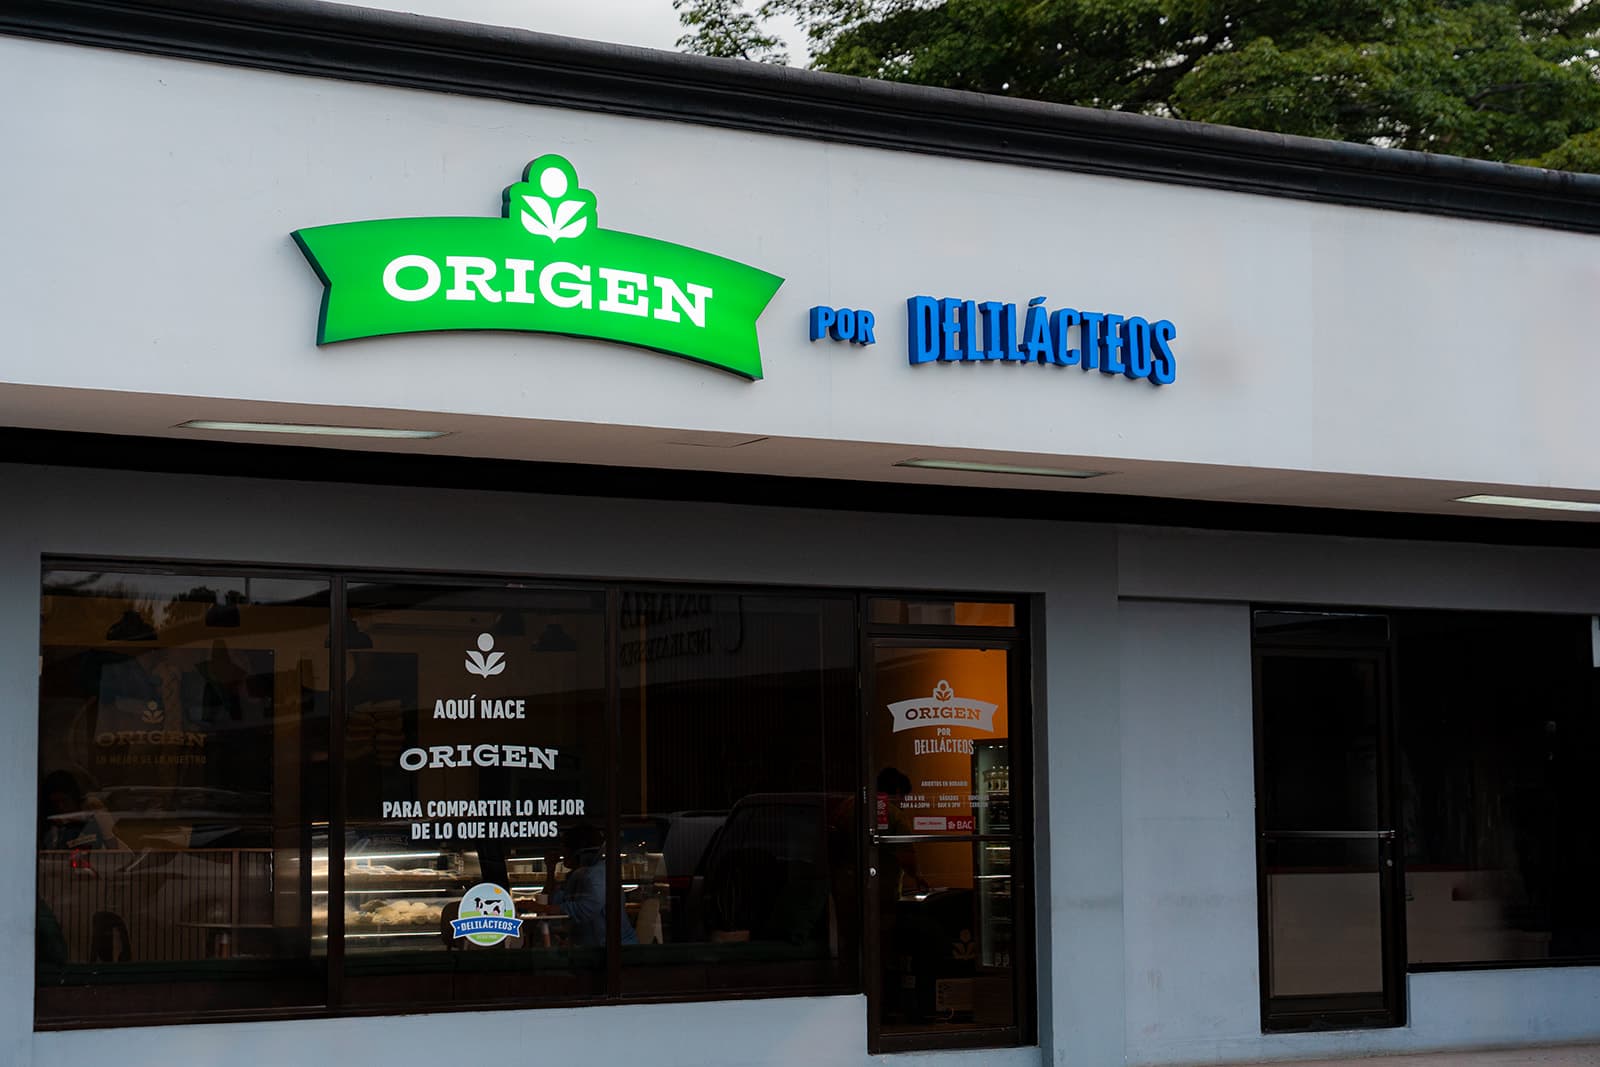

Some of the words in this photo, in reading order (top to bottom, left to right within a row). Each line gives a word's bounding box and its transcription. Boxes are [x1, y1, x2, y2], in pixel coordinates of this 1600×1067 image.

[382, 254, 713, 328] ORIGEN
[809, 305, 877, 346] POR
[907, 295, 1177, 386] DELILÁCTEOS
[433, 694, 477, 720] AQUÍ
[480, 699, 526, 719] NACE
[905, 707, 982, 721] ORIGEN
[937, 728, 951, 736] POR
[914, 737, 975, 755] DELILÁCTEOS
[399, 744, 559, 771] ORIGEN
[382, 801, 423, 818] PARA
[427, 800, 512, 818] COMPARTIR
[516, 800, 534, 816] LO
[537, 799, 585, 816] MEJOR
[411, 823, 431, 840] DE
[434, 822, 453, 839] LO
[457, 822, 486, 840] QUE
[488, 821, 558, 839] HACEMOS
[956, 820, 973, 829] BAC
[460, 919, 513, 931] DELILÁCTEOS
